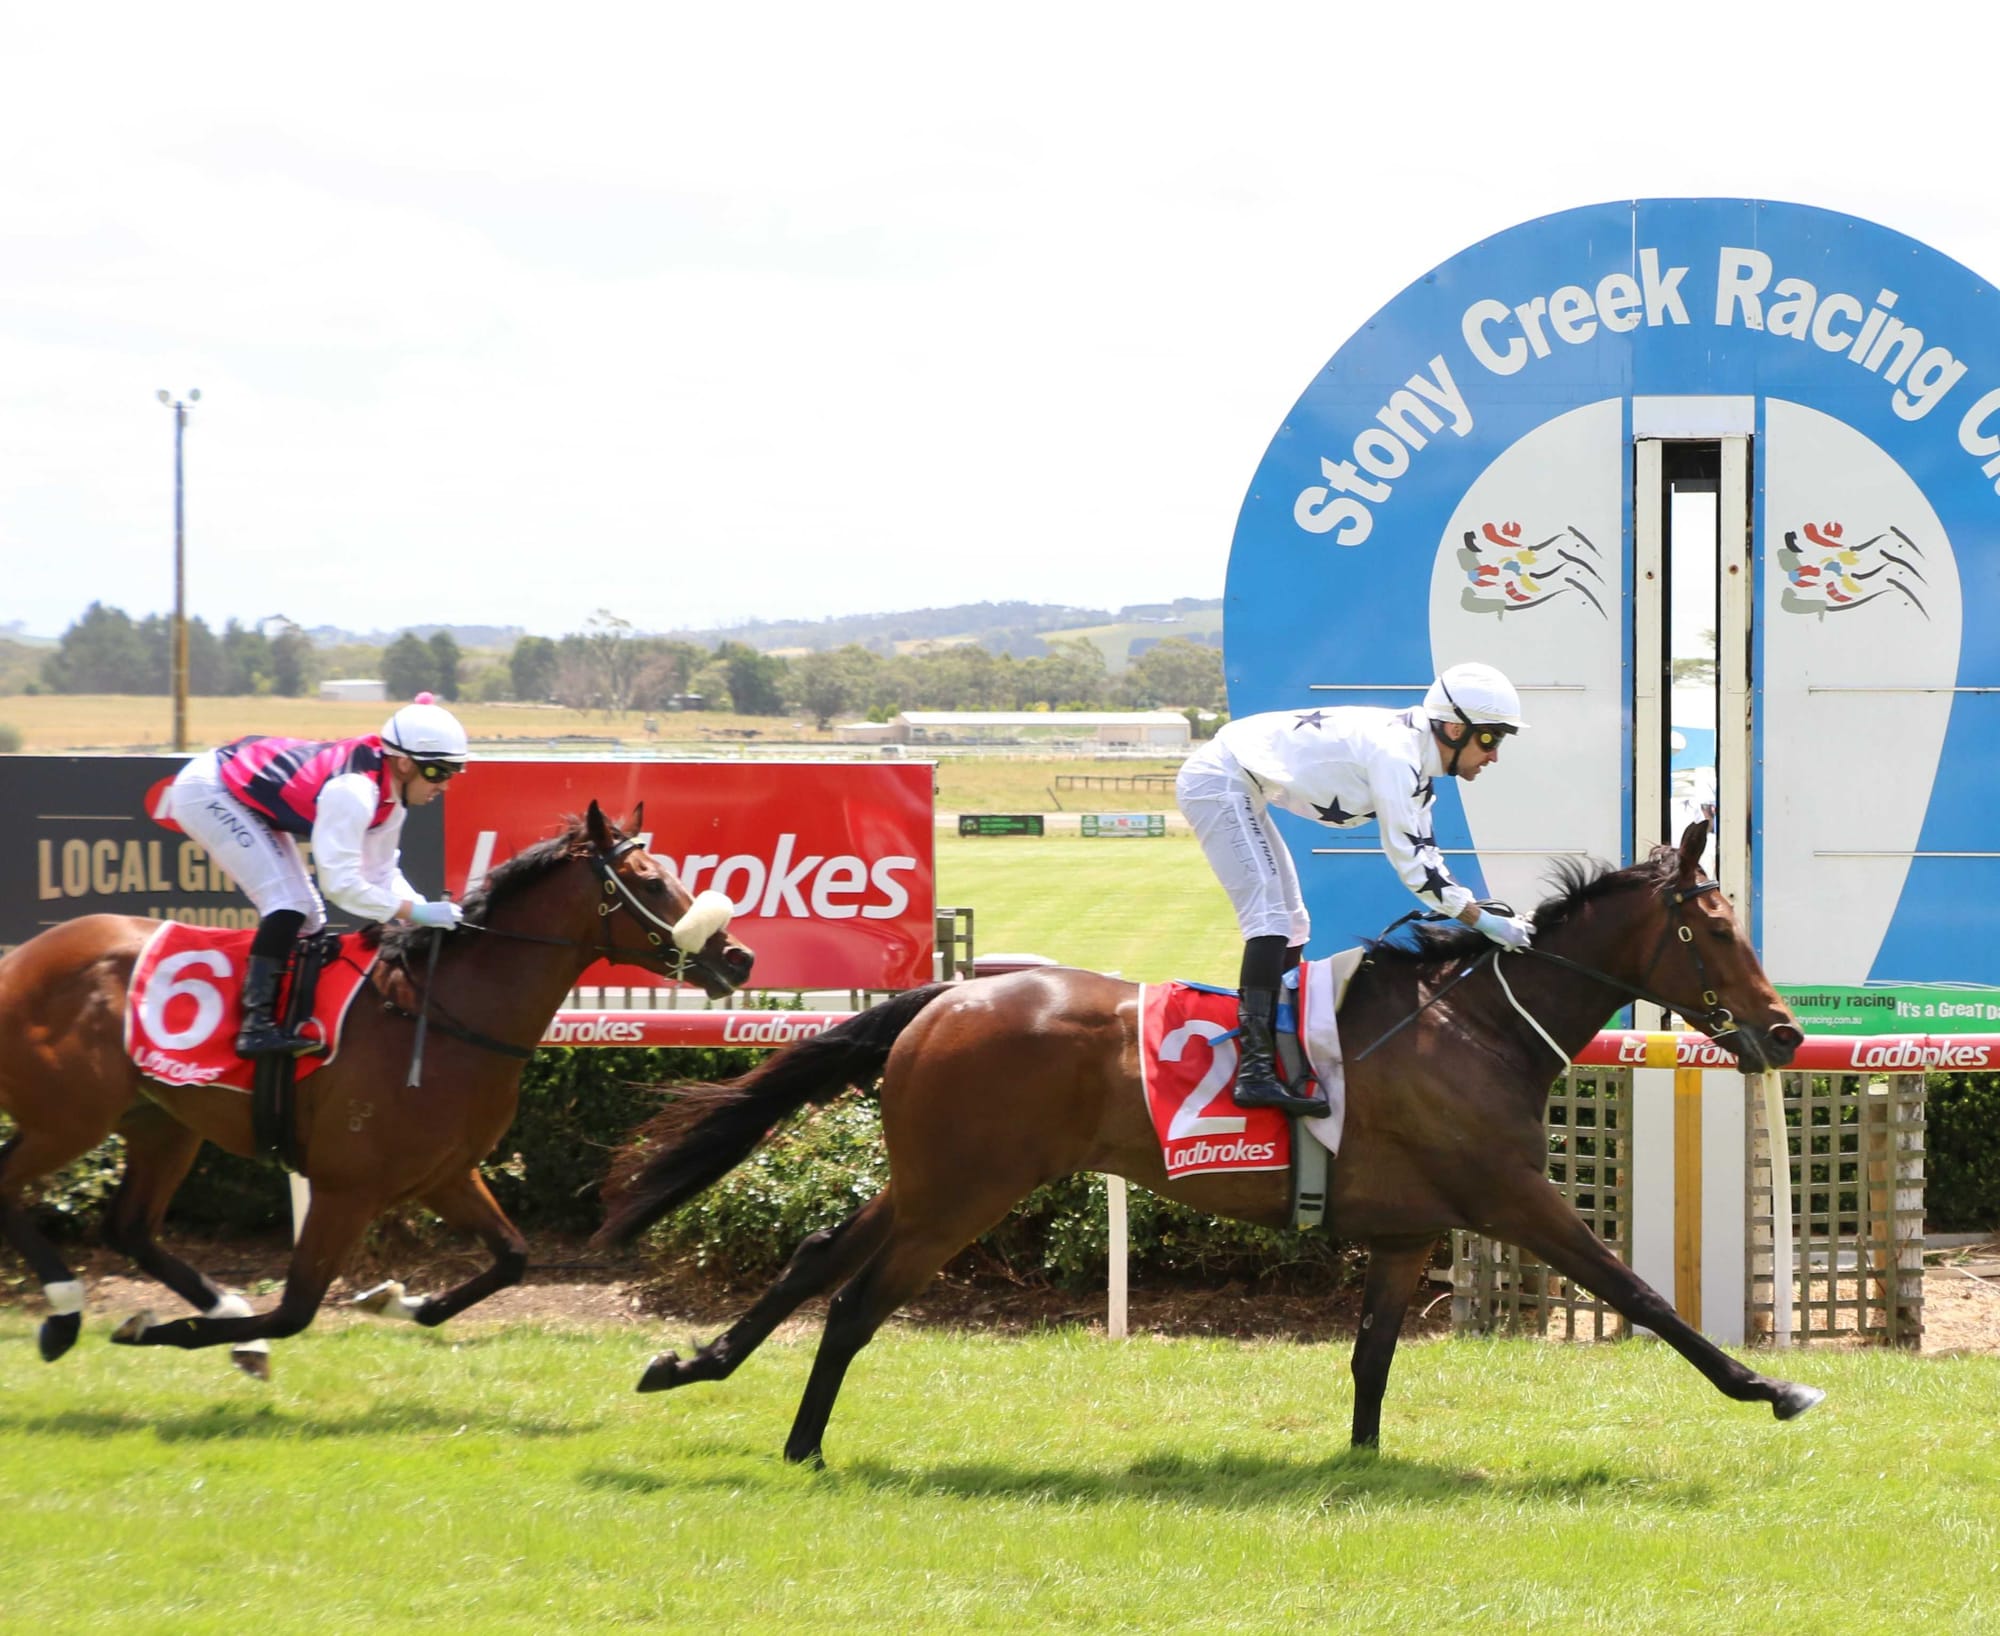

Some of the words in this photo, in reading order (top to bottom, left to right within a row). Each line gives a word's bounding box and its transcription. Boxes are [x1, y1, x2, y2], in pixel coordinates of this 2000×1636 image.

[1293, 353, 1475, 546] Stony
[1462, 248, 1691, 376] Creek
[1715, 246, 1969, 422] Racing
[205, 801, 255, 848] KING
[38, 839, 172, 900] LOCAL
[463, 831, 917, 919] Lrokes
[138, 950, 233, 1050] 6
[1846, 993, 1897, 1010] racing
[1897, 1001, 1921, 1018] It's
[1925, 1003, 1935, 1017] a
[541, 1015, 646, 1042] brokes
[1158, 1019, 1247, 1142] 2
[1164, 1139, 1276, 1171] Ladbrokes
